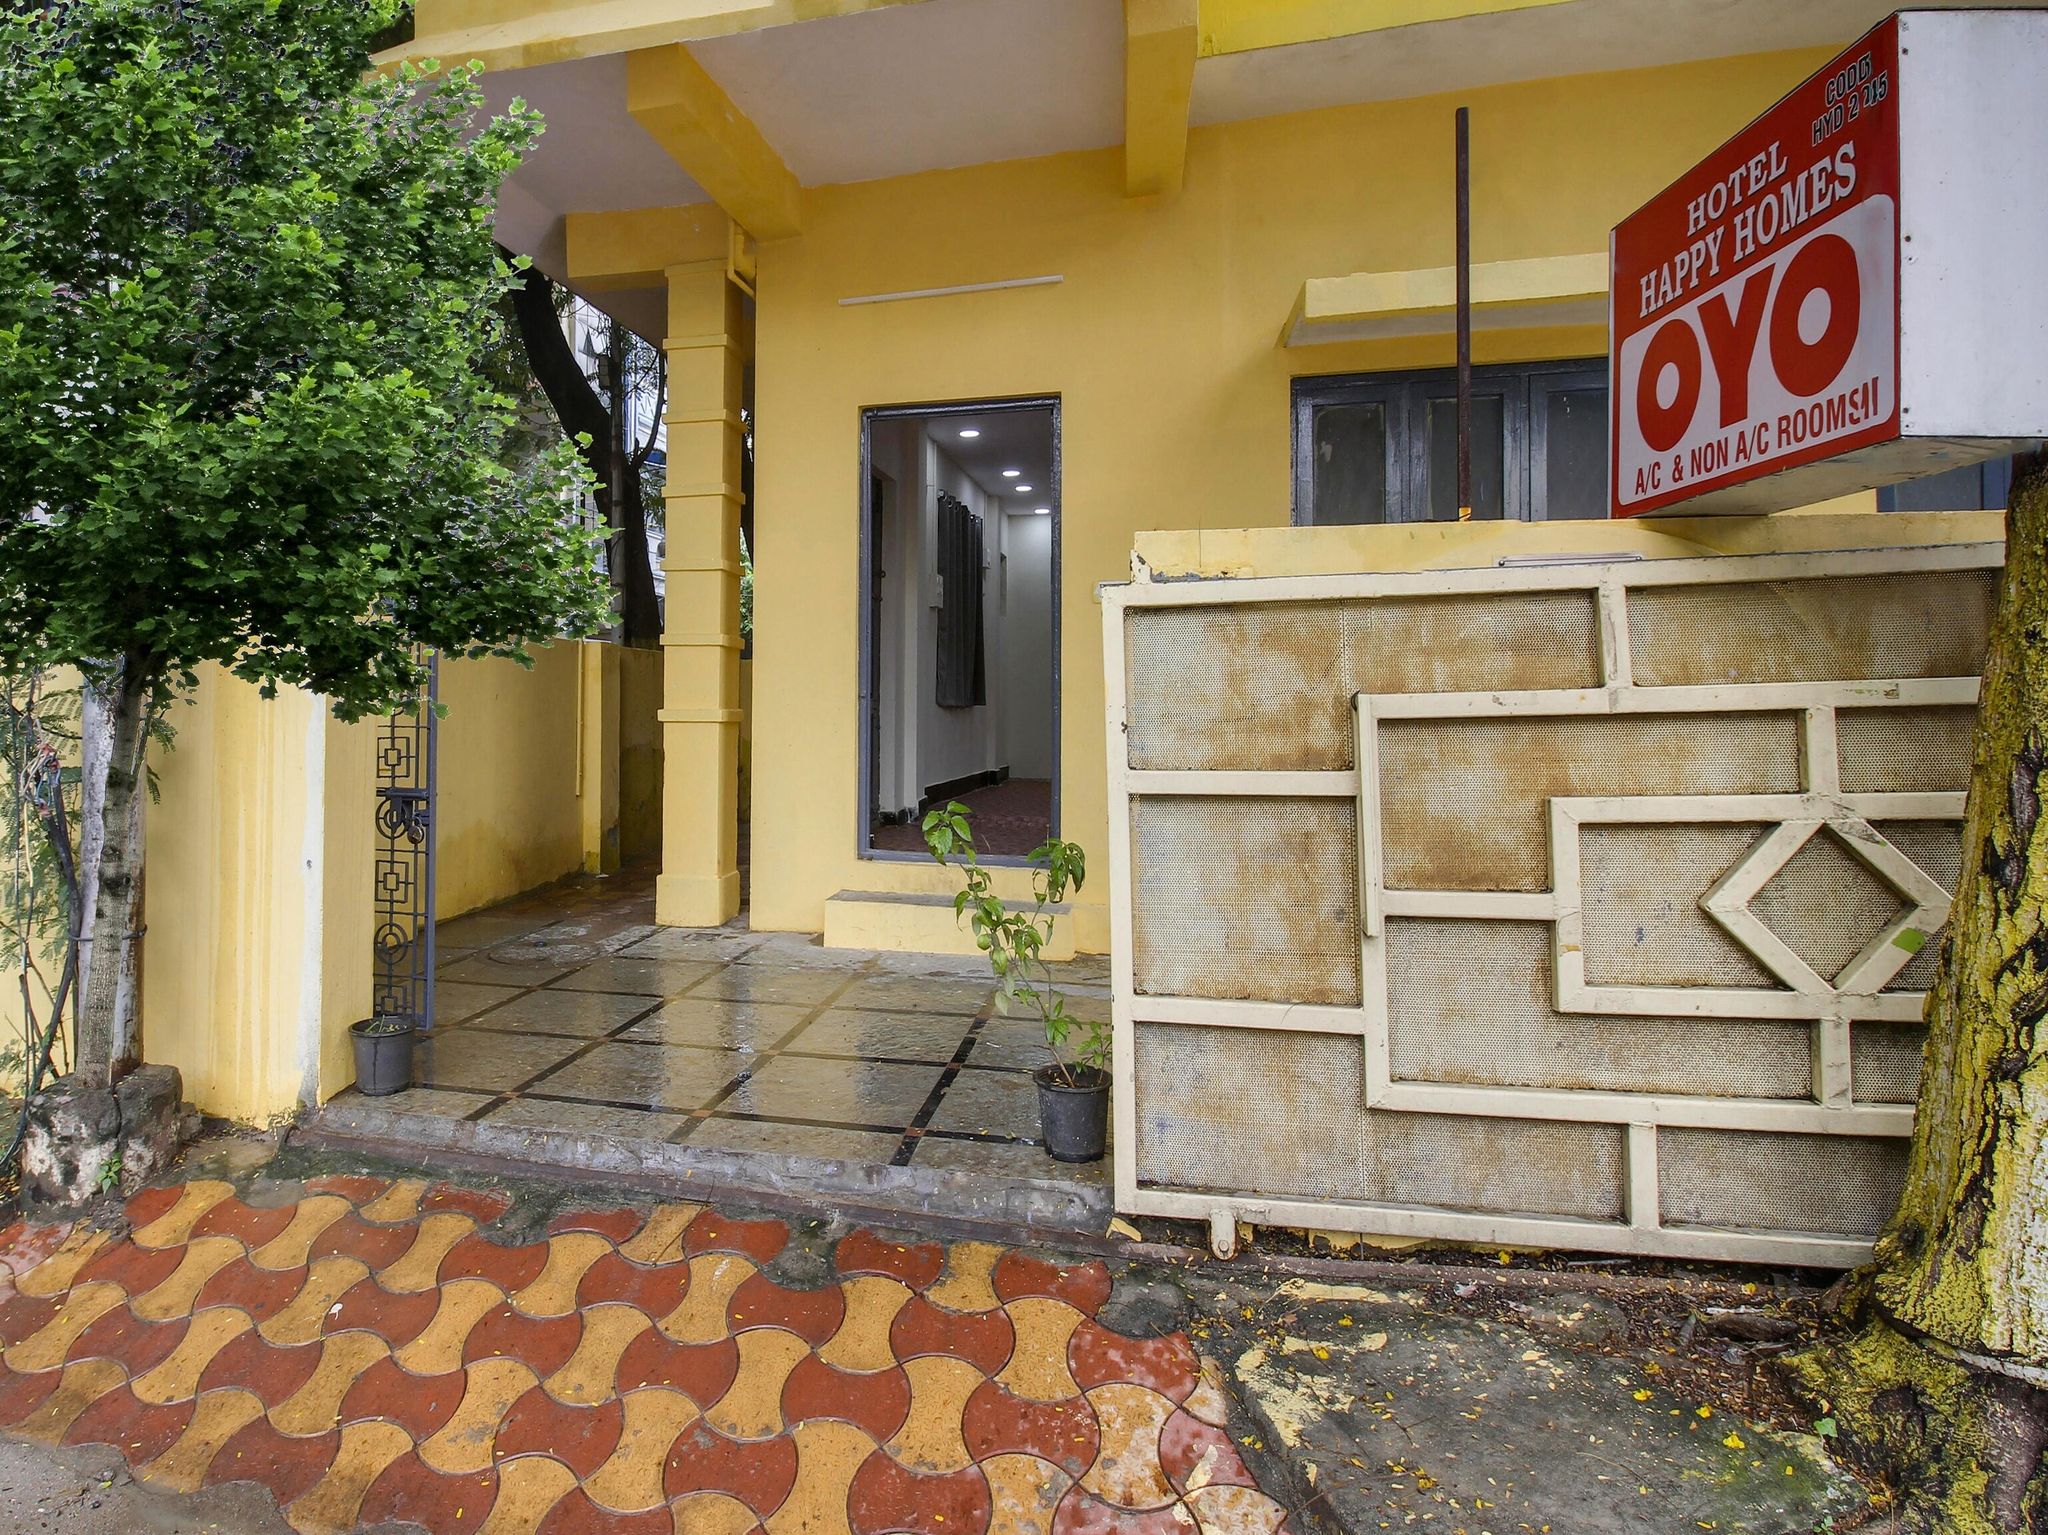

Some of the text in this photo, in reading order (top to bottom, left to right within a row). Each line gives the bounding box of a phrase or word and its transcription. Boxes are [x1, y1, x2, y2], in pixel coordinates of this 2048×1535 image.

[1811, 102, 1844, 147] HYD
[1639, 140, 1857, 319] HAPPY HOMES
[1687, 140, 1788, 238] HOTEL
[1636, 232, 1861, 453] OYO
[1635, 460, 1662, 496] A/C
[1671, 453, 1684, 484] &
[1690, 436, 1729, 478] NON
[1735, 420, 1770, 463] A/C
